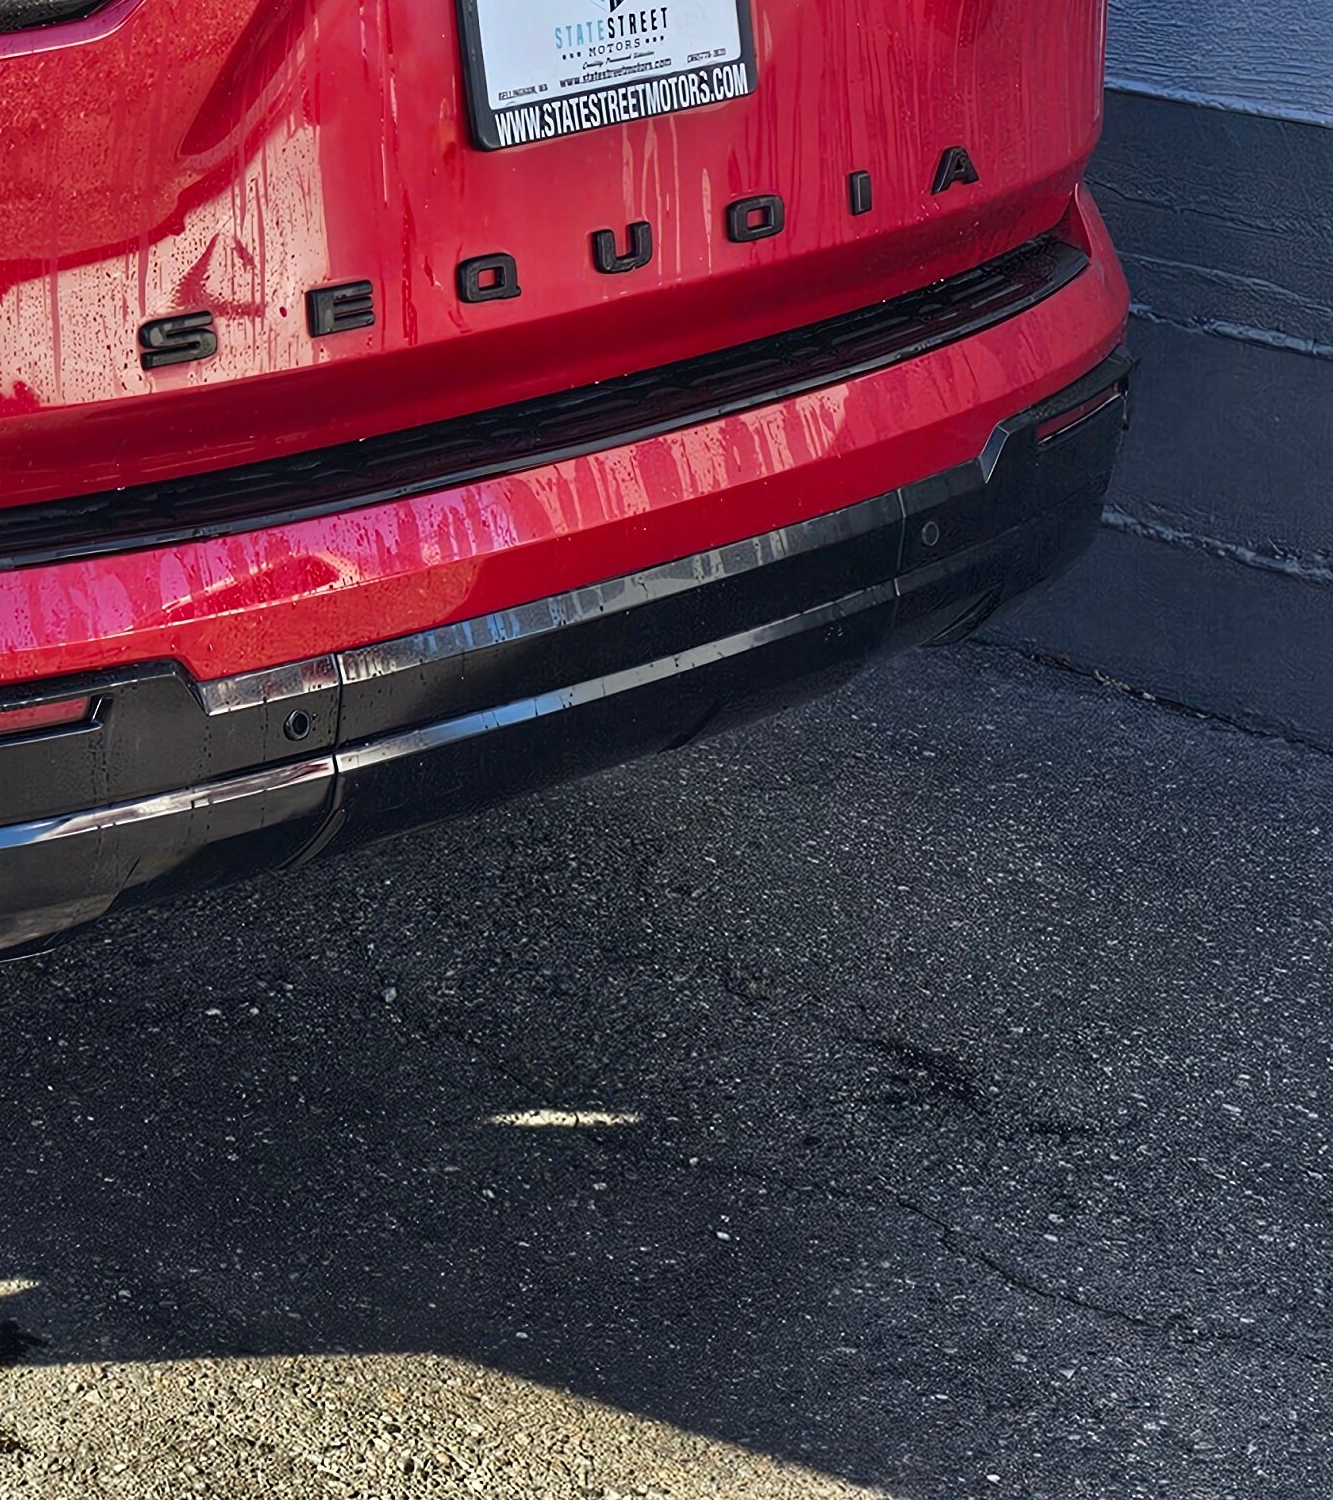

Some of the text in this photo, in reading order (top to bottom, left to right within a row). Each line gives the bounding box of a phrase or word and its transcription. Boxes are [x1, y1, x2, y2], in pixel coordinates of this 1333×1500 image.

[588, 38, 641, 58] MOTORS
[495, 62, 749, 147] WWW.STATESTREETMOTORS.COM
[138, 144, 981, 371] SEQUOIA
